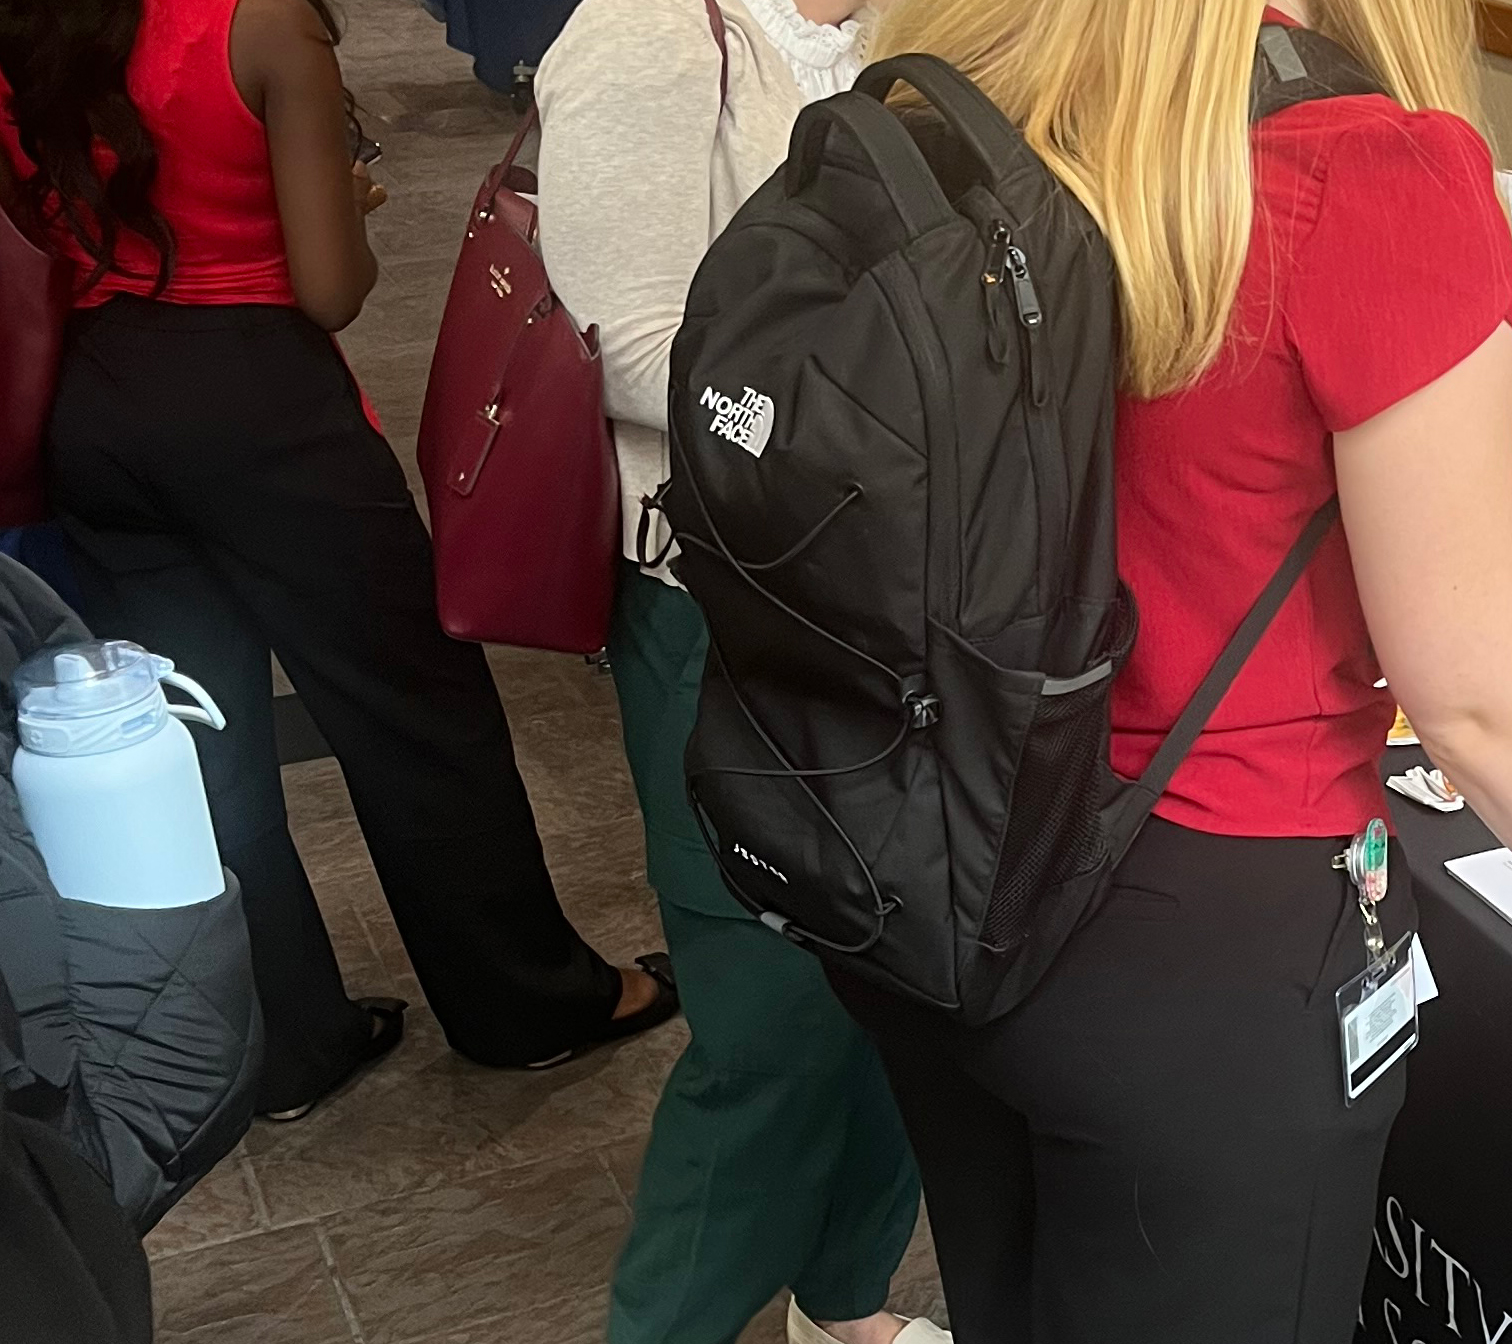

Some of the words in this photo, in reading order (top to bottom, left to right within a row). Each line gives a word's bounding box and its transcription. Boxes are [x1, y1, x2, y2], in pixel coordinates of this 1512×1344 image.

[700, 386, 756, 429] NORTH
[741, 386, 766, 412] THE
[709, 414, 755, 447] FACE
